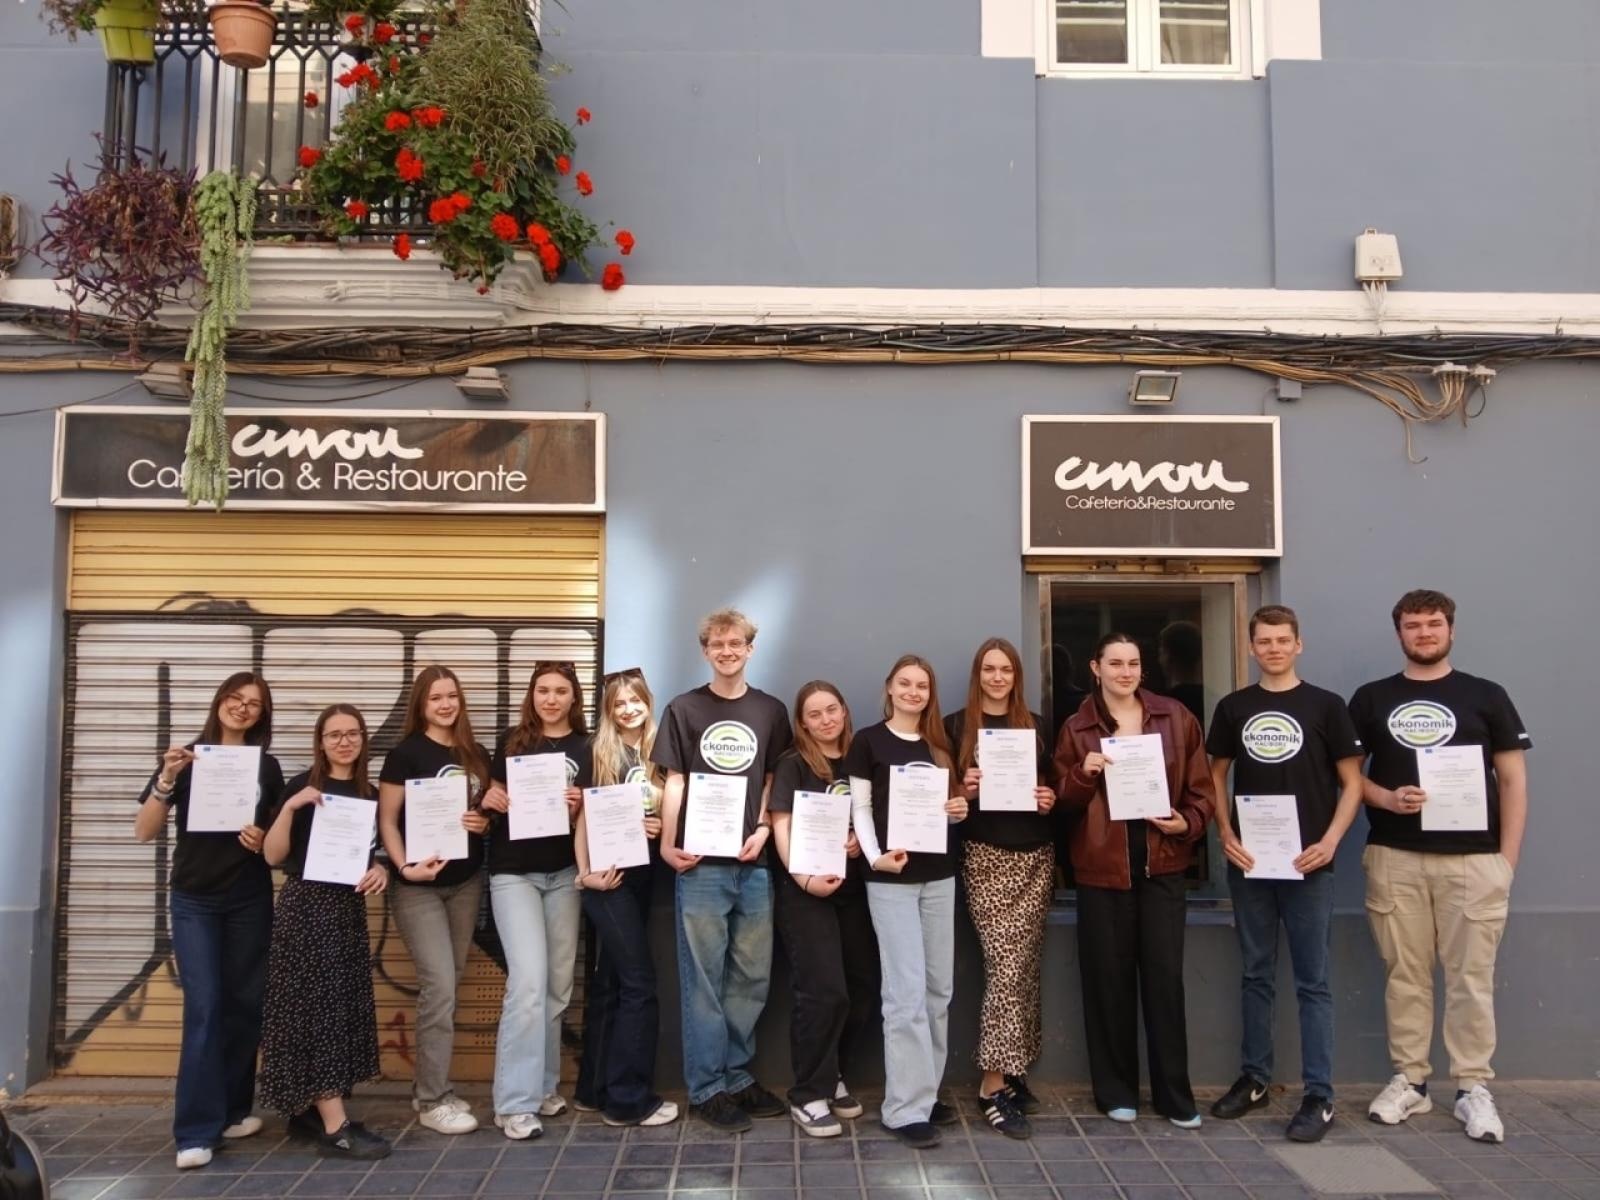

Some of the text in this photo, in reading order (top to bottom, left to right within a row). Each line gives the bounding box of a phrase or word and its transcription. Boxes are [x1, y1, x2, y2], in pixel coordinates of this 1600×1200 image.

[128, 459, 528, 492] Caería & Restaurante
